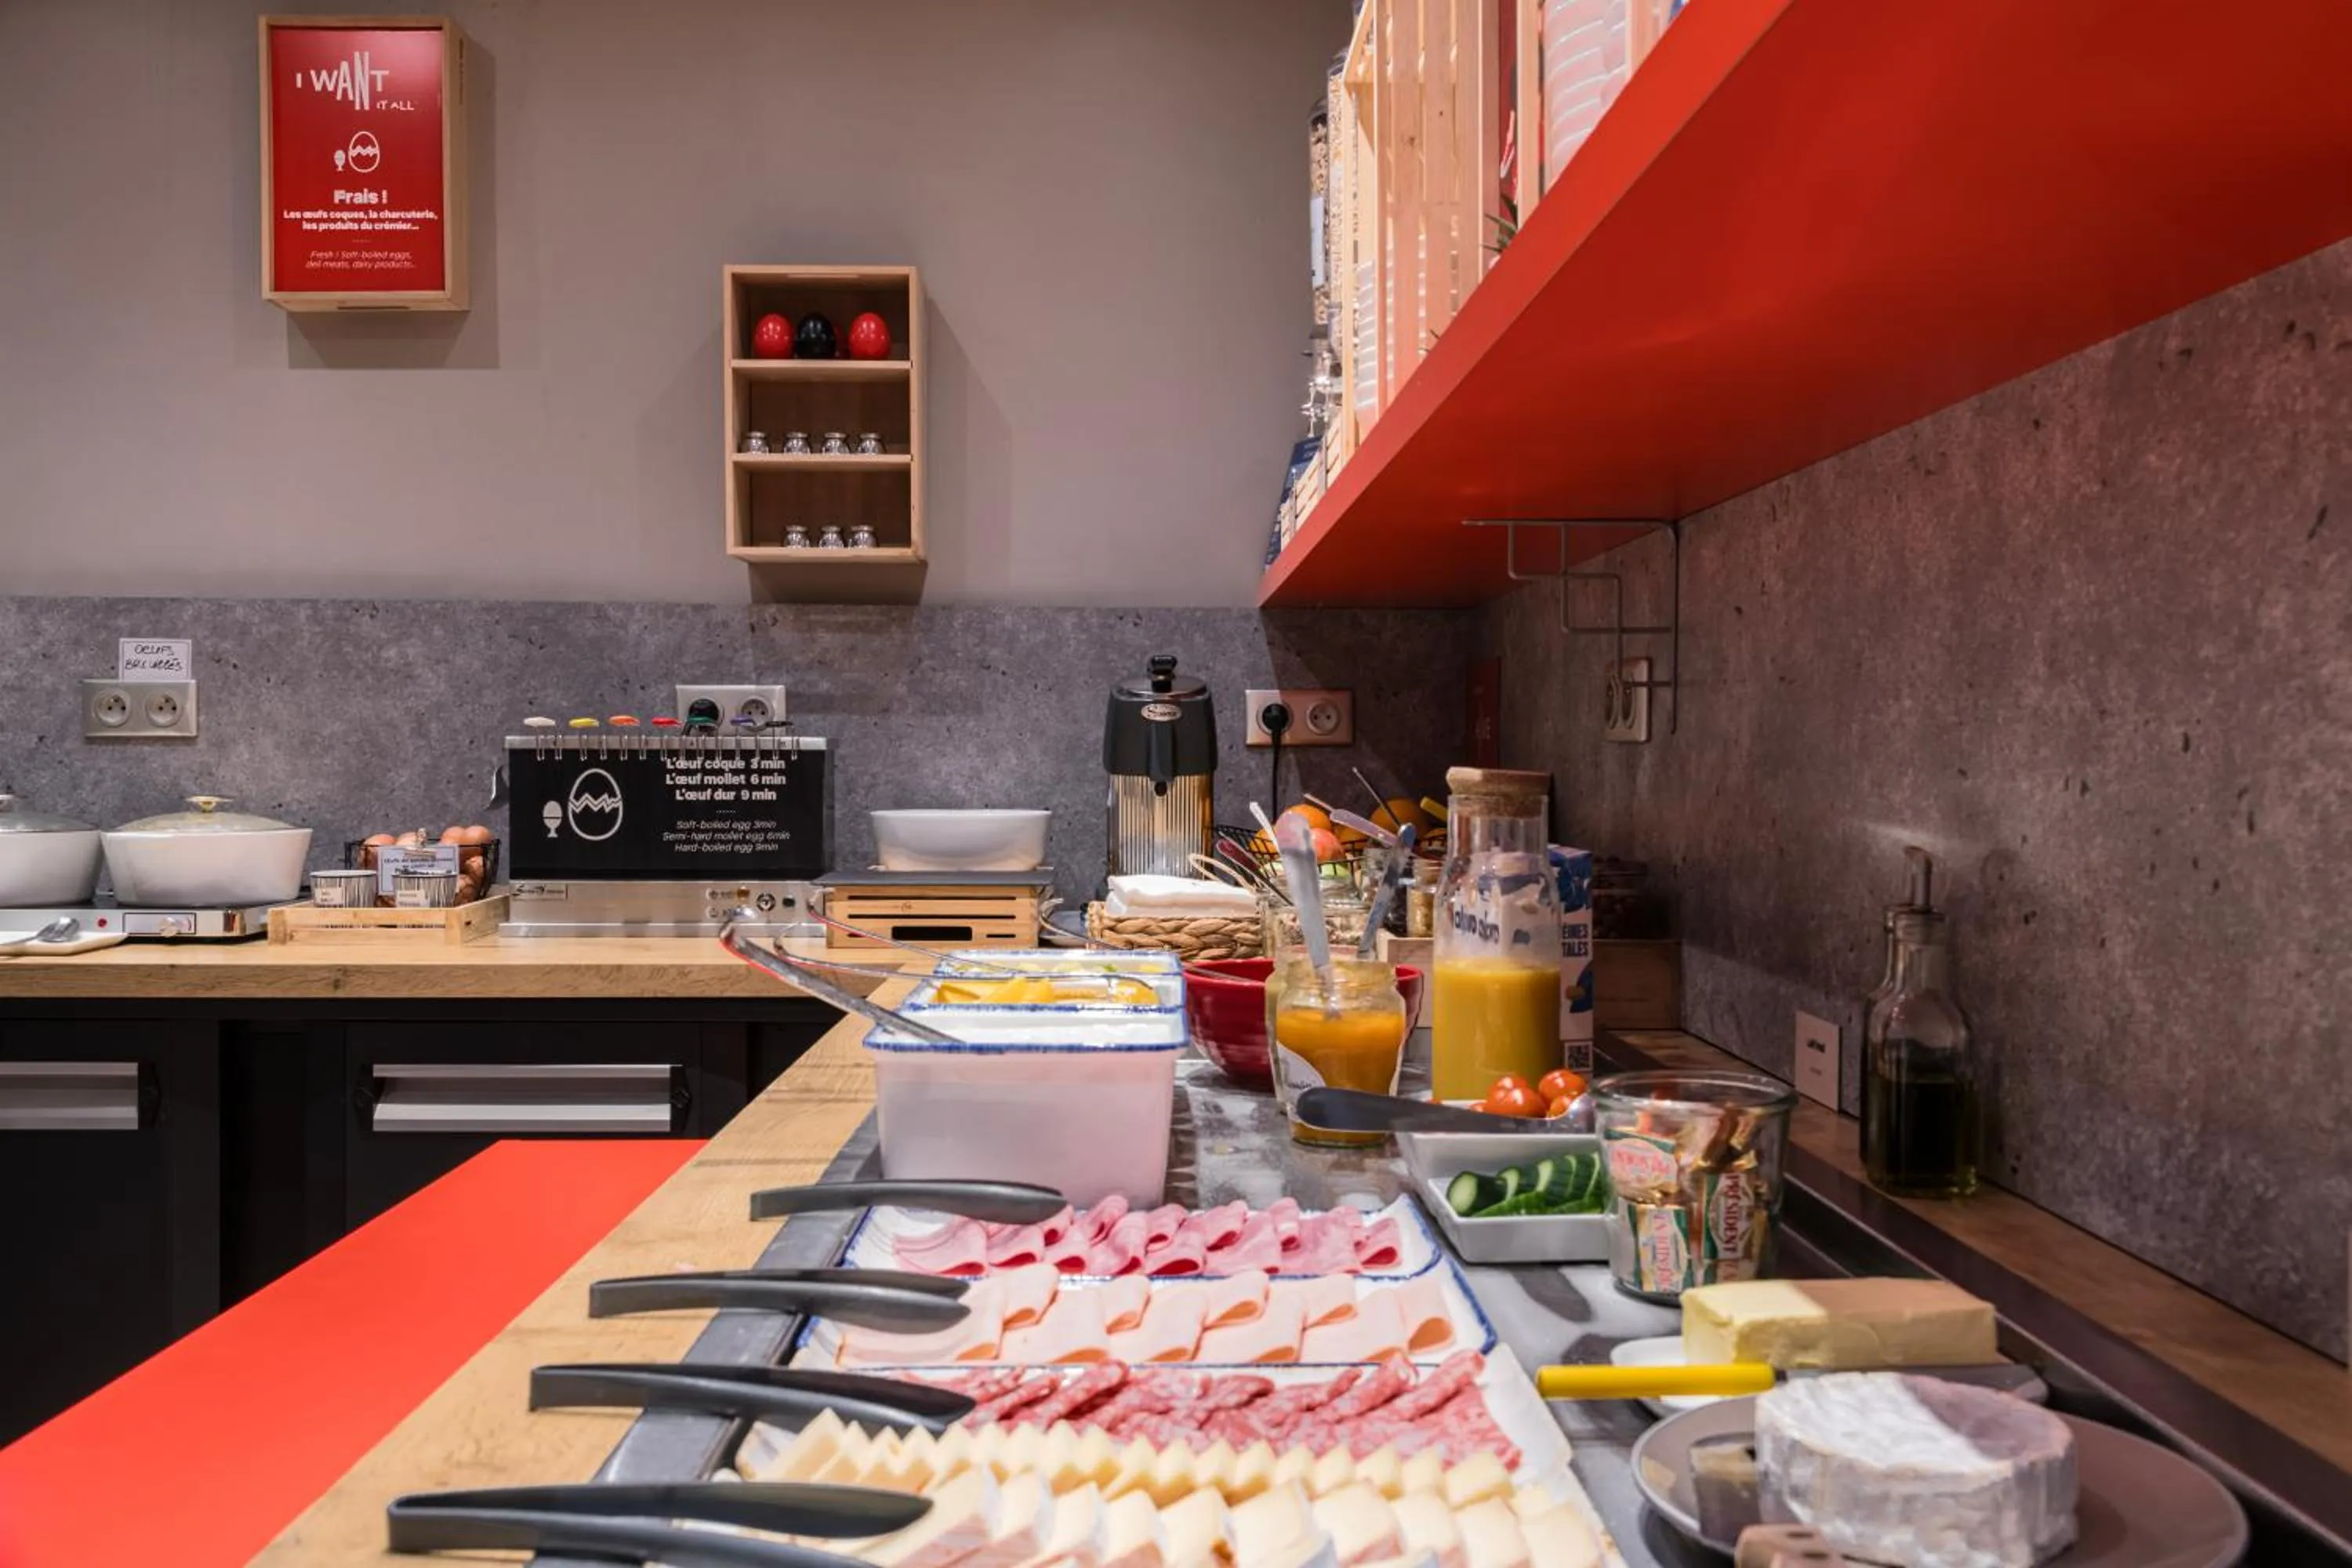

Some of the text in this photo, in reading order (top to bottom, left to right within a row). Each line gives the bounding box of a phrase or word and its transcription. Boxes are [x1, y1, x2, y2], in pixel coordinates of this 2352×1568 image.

[296, 50, 390, 111] I WANT
[376, 100, 415, 111] IT ALL
[333, 187, 388, 204] Frais !
[283, 209, 438, 221] Les œufs coques, la charcuterie,
[302, 221, 318, 230] les
[318, 220, 360, 232] produits
[360, 221, 373, 230] du
[310, 250, 334, 260] Fresh
[705, 758, 745, 771] coque
[750, 757, 760, 769] 3
[760, 757, 786, 769] min
[704, 773, 746, 785] mollet
[750, 774, 760, 785] 6
[761, 773, 786, 785] min
[713, 789, 736, 800] dur
[741, 789, 750, 800] 9
[752, 789, 777, 800] min
[677, 820, 777, 831] Soft-boiled egg 3min
[662, 832, 712, 841] Semi-hard
[714, 832, 744, 840] mollet
[746, 833, 765, 843] egg
[674, 843, 732, 852] Hard-boiled
[733, 844, 753, 853] egg
